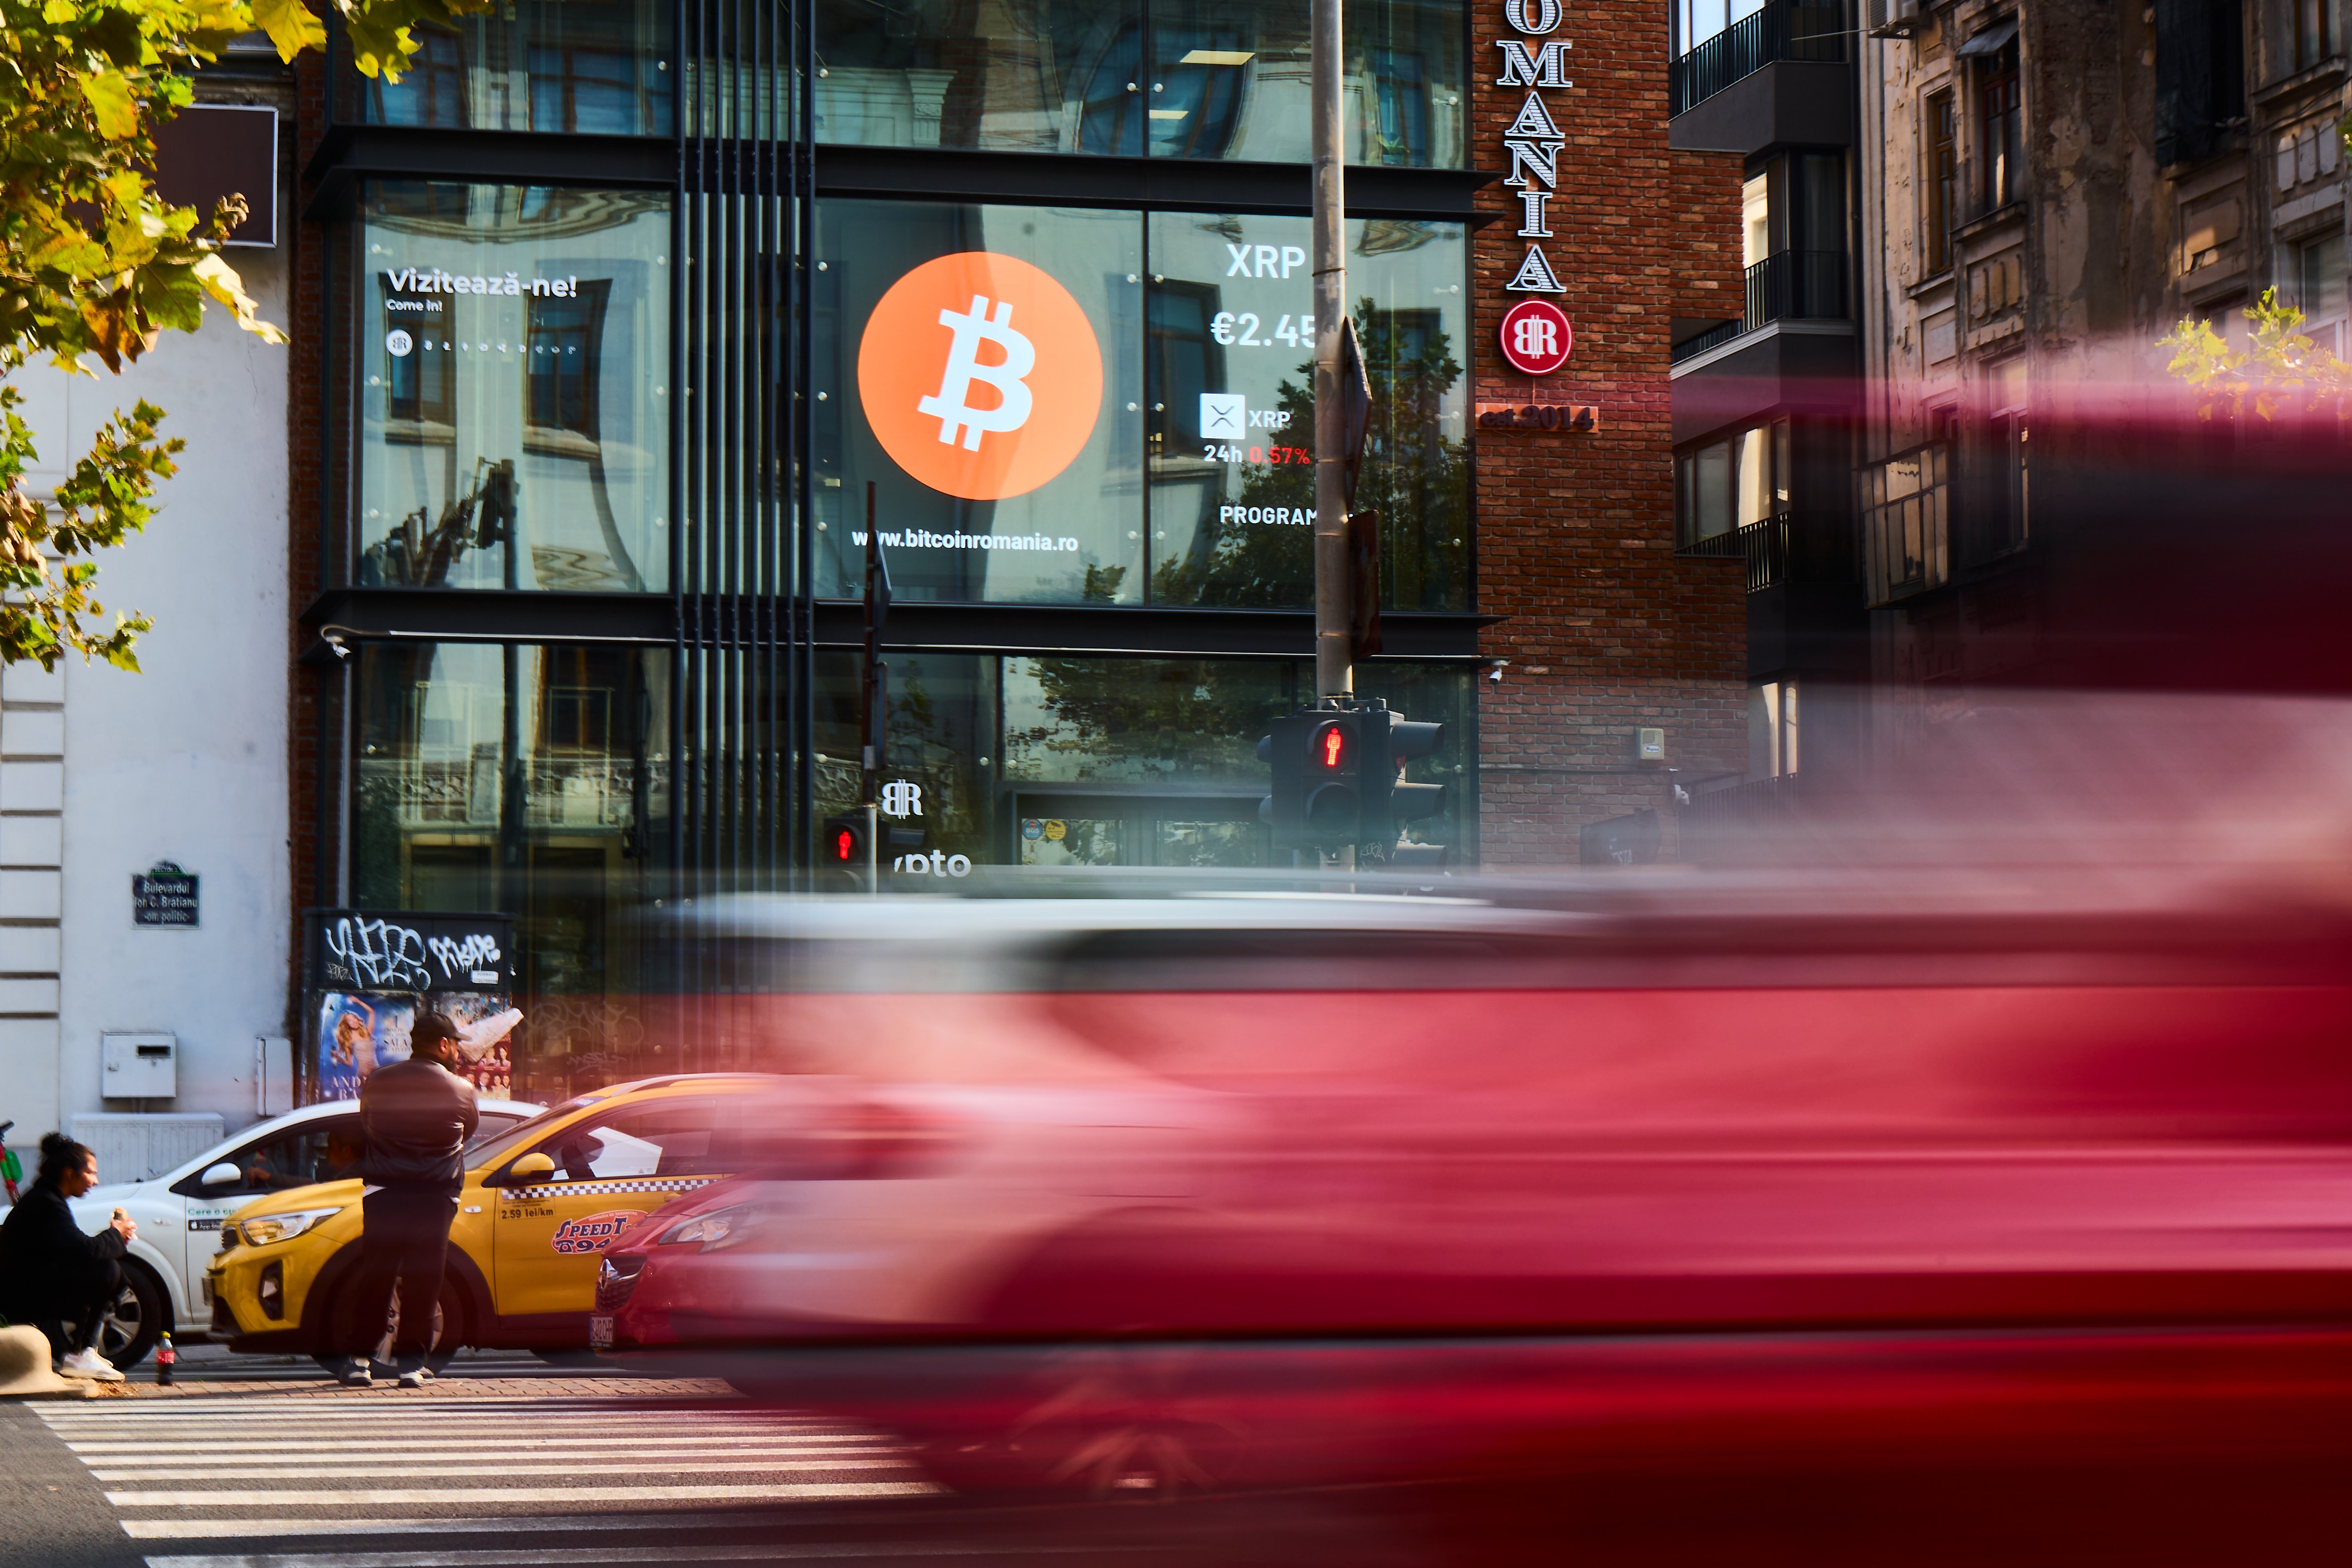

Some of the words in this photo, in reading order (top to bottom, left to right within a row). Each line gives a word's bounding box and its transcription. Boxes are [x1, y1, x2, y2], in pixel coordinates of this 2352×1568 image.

[1226, 244, 1306, 279] XRP
[386, 267, 577, 298] Vizitează-ne!
[386, 299, 424, 312] Come
[425, 299, 442, 312] in!
[1249, 410, 1290, 428] XRP
[1204, 445, 1242, 463] 24h
[1250, 446, 1310, 465] 0.57%
[144, 881, 190, 894] Bulevardul
[502, 1209, 521, 1219] 2.59
[526, 1208, 553, 1217] lei/km
